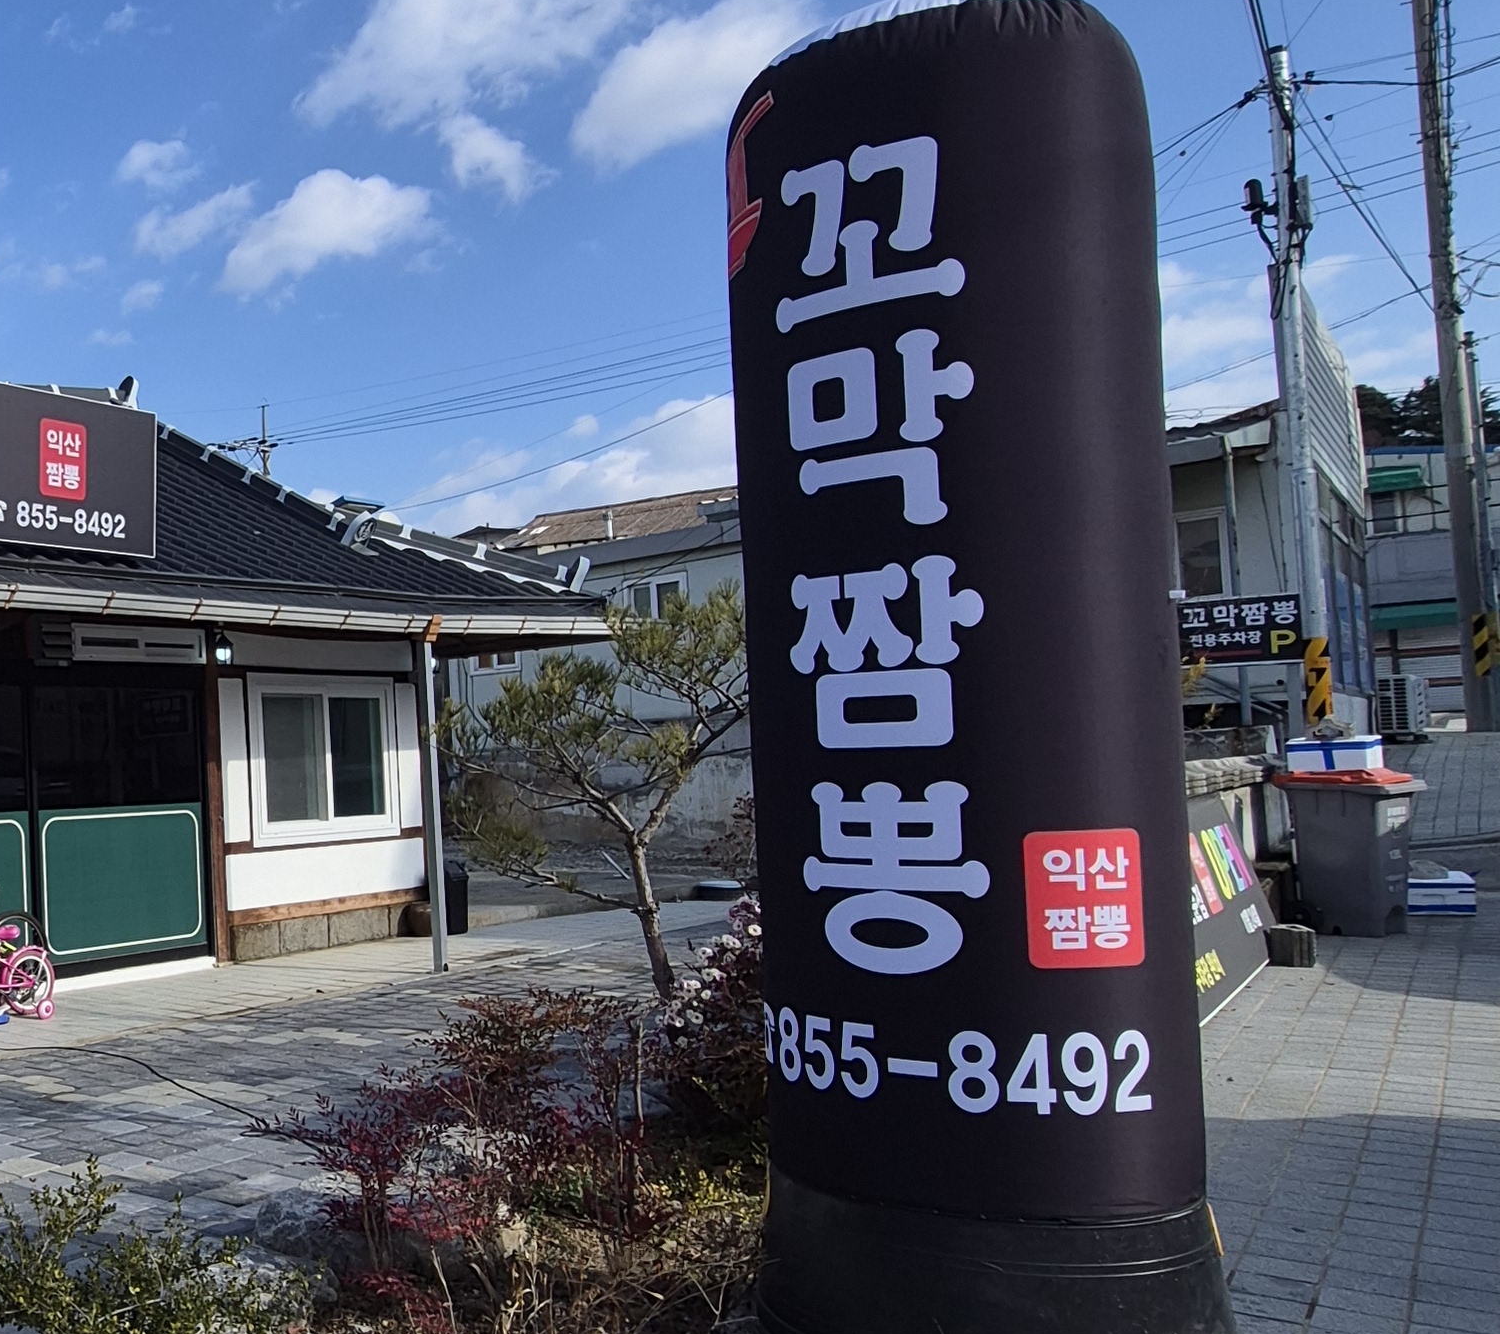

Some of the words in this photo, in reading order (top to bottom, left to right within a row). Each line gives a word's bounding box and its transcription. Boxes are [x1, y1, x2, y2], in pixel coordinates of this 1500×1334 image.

[45, 428, 82, 459] 익산
[45, 461, 82, 491] 짬뽕
[15, 500, 127, 540] 855-8492
[775, 134, 991, 975] 꼬막짬뽕
[1181, 600, 1299, 629] 꼬막짬뽕
[1270, 629, 1297, 654] P
[1042, 845, 1130, 892] 익산
[1200, 822, 1254, 900] OPEN
[1043, 904, 1132, 951] 짬뽕
[778, 1005, 1153, 1116] 855-8492
